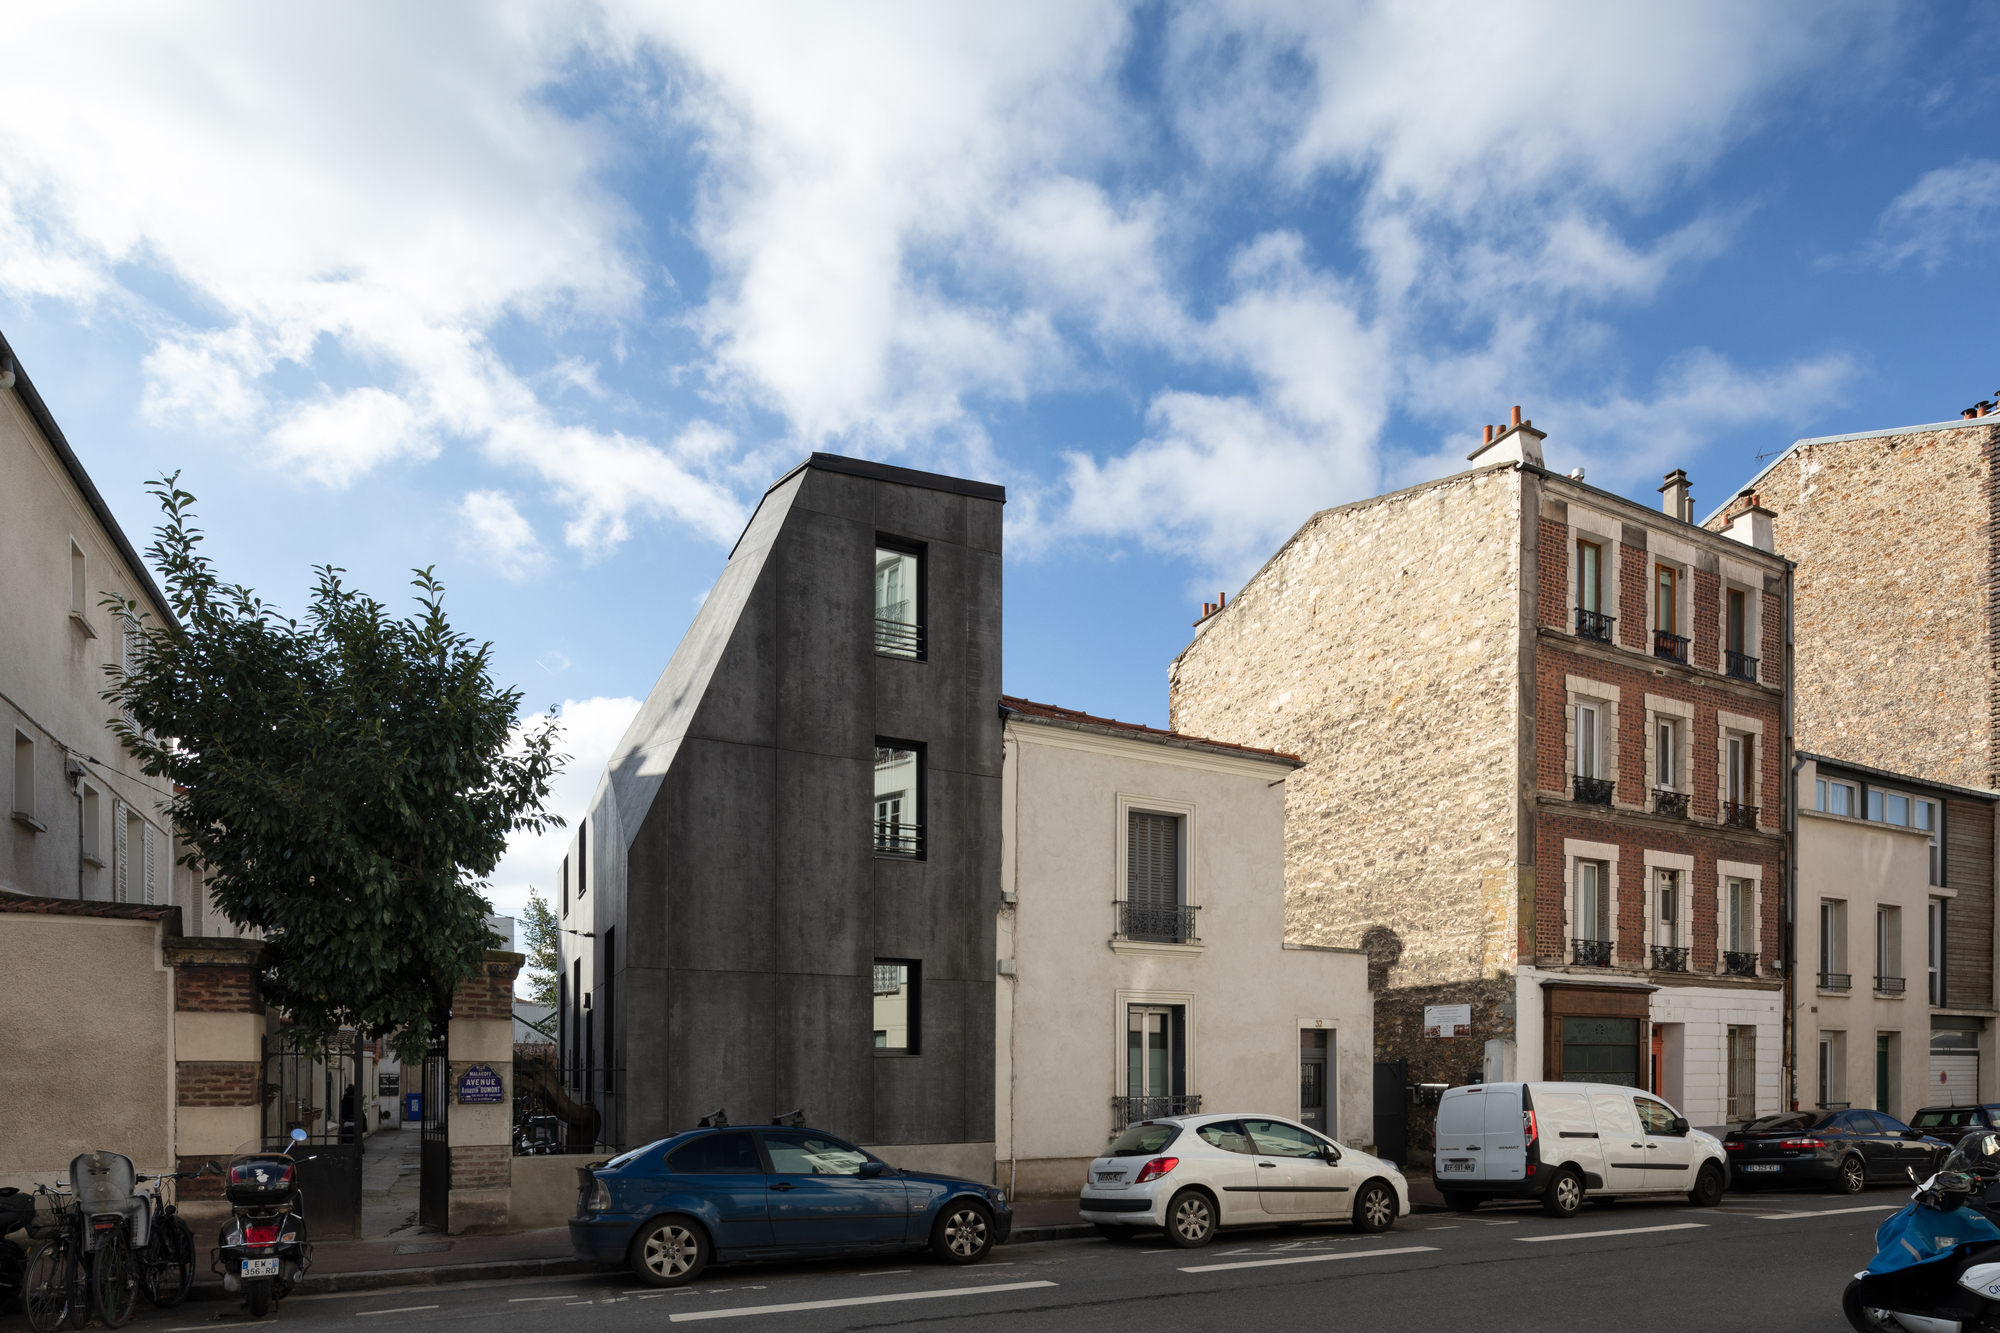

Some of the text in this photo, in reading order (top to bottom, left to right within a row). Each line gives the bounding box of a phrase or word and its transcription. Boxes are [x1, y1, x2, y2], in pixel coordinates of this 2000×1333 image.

[1315, 1019, 1323, 1028] 32
[466, 1078, 496, 1086] AVENUE
[244, 1267, 277, 1276] 356-RD
